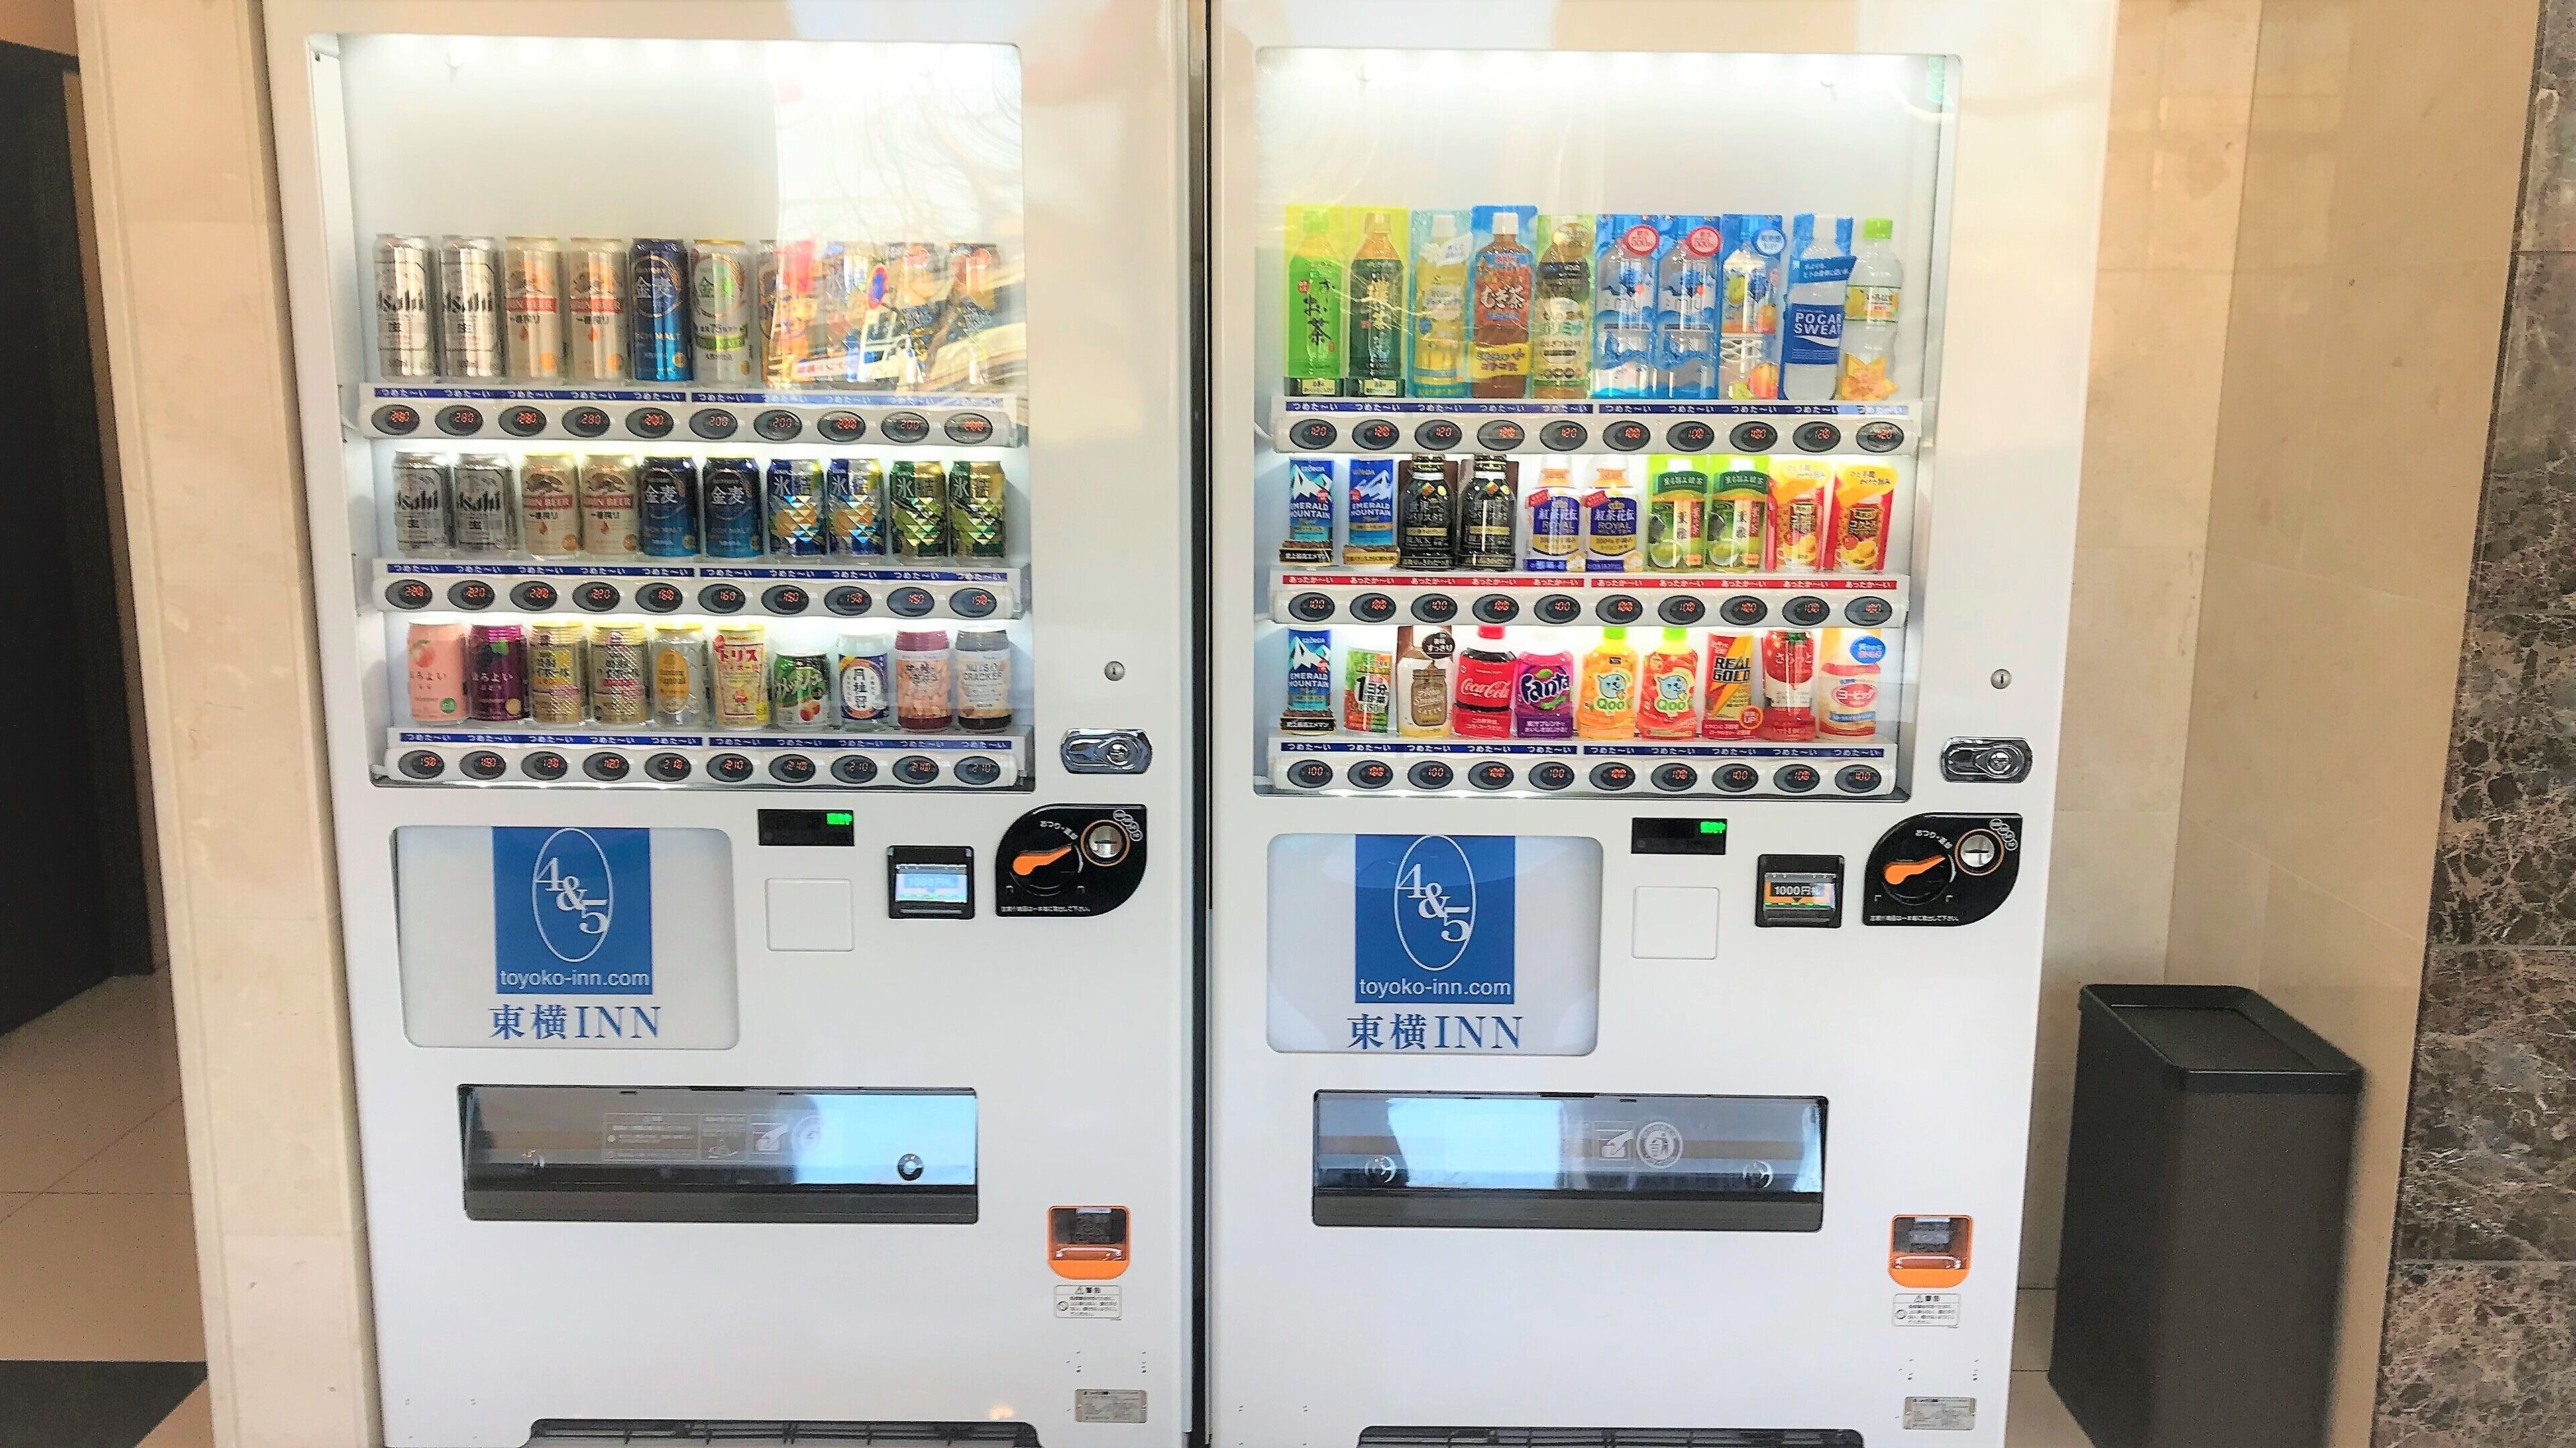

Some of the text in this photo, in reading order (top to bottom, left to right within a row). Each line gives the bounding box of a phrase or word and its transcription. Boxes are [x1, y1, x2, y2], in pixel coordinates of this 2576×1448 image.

[1480, 284, 1526, 309] むぎ茶
[645, 484, 678, 504] 金麦
[710, 486, 746, 505] 金麦
[1593, 508, 1635, 521] 紅茶花伝
[1597, 521, 1631, 531] ROYAL
[1309, 600, 1325, 610] 100
[1432, 600, 1448, 610] 100
[1427, 643, 1453, 653] すっきり
[719, 649, 758, 662] トリス
[1714, 657, 1752, 669] REAL
[1289, 672, 1328, 680] EMERALD
[1712, 669, 1751, 682] GOLD
[853, 668, 867, 709] 月桂冠
[1521, 673, 1571, 705] Fanta
[1596, 698, 1625, 710] Qoo
[1656, 698, 1686, 711] Qoo
[1743, 716, 1756, 724] UP
[849, 762, 869, 772] 210
[1307, 767, 1324, 777] 100
[1428, 767, 1444, 777] 100
[1549, 768, 1565, 778] 100
[535, 856, 609, 934] 4&5
[1397, 862, 1472, 942] 4&5
[499, 969, 651, 990] toyoko-inn.com
[1358, 977, 1511, 999] toyoko-inn.com
[487, 1003, 662, 1040] 東横INN
[1346, 1012, 1524, 1051] 東横INN
